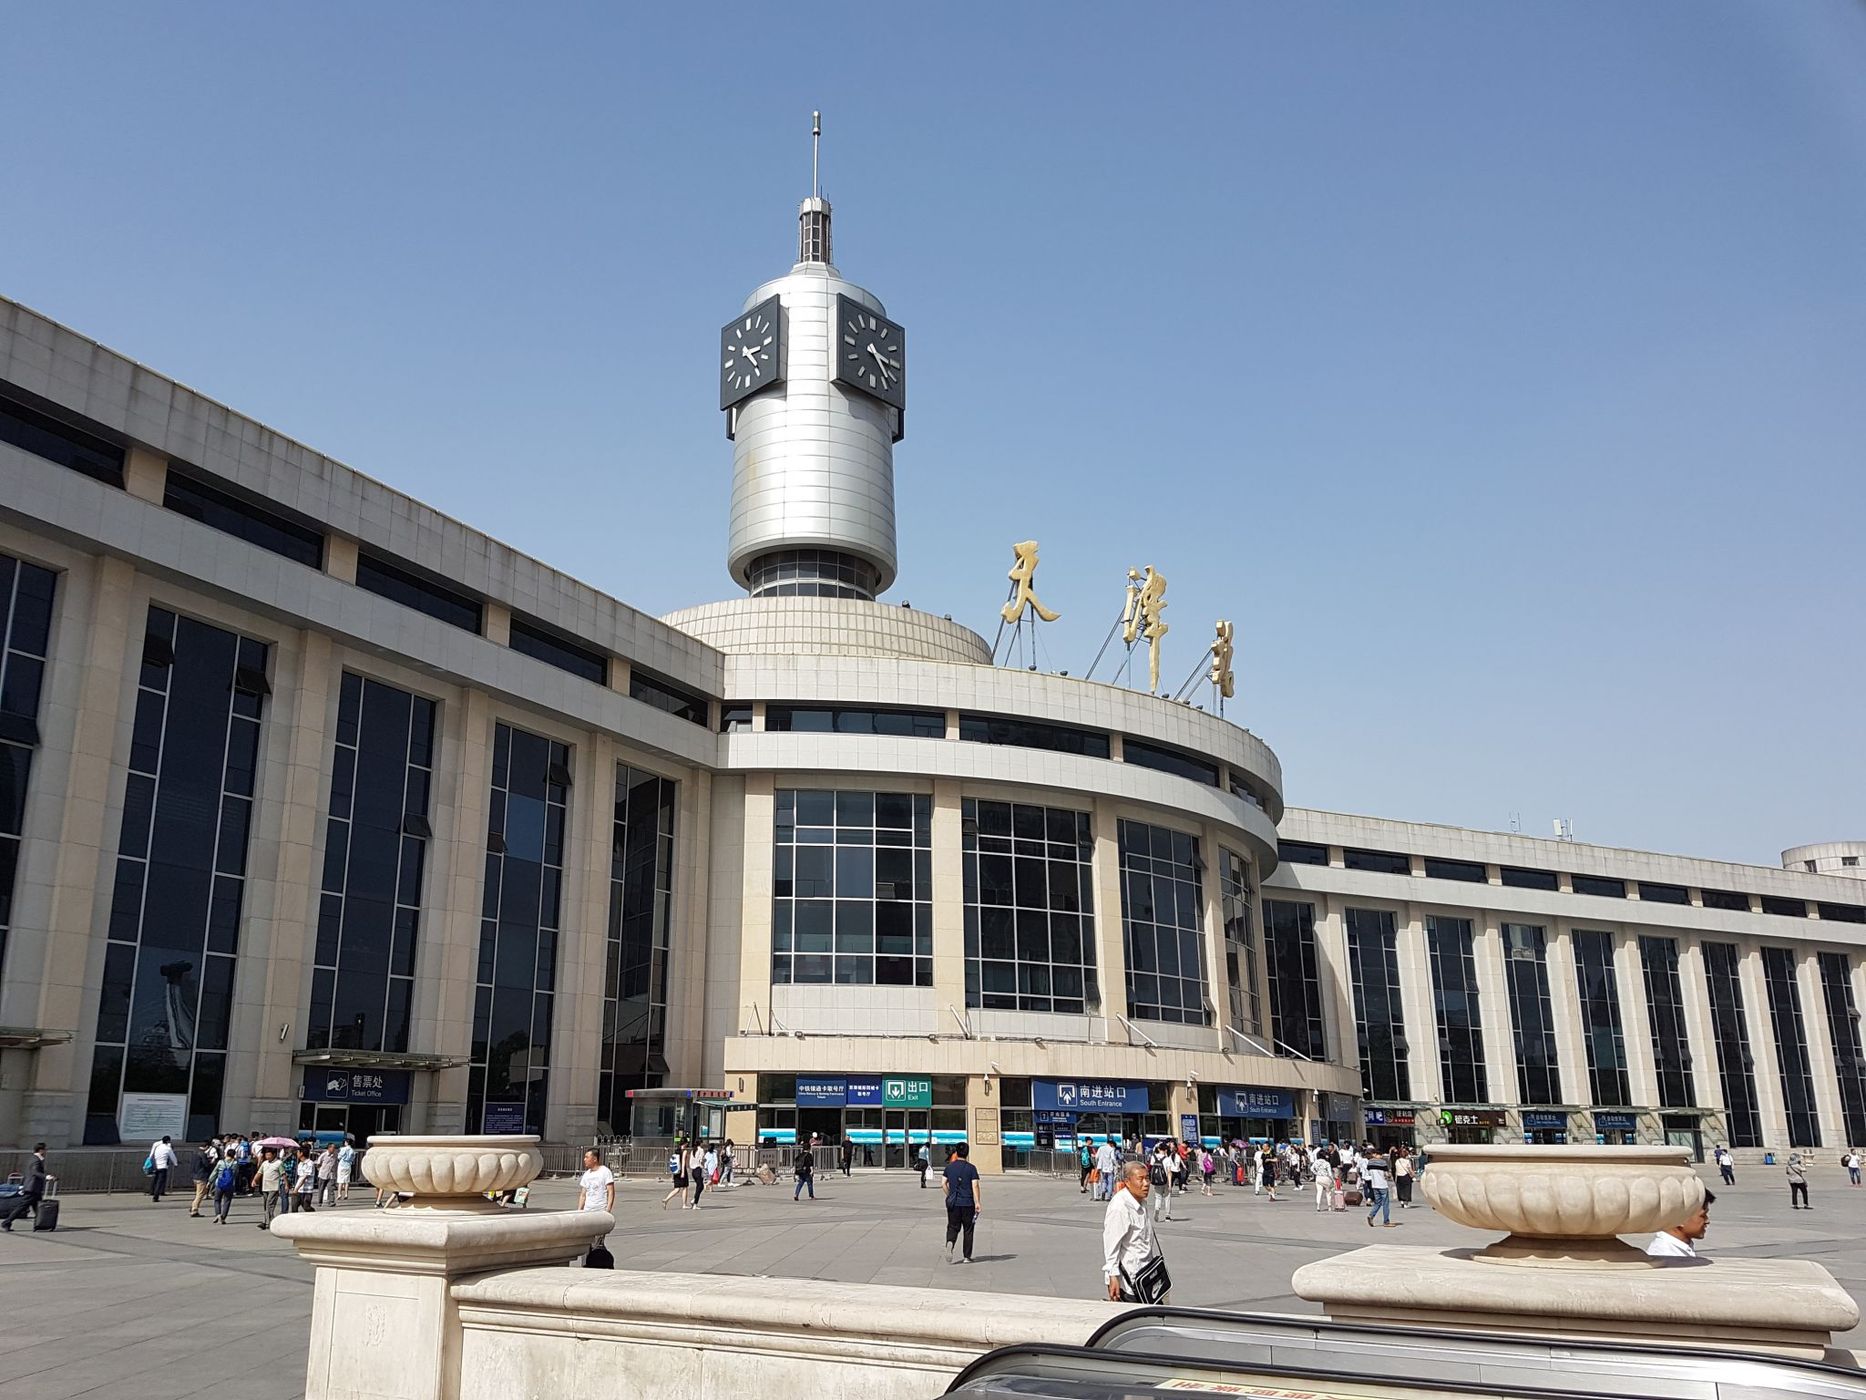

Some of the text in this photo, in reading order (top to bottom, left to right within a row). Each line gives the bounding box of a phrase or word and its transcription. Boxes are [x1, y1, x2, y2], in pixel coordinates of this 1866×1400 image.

[352, 1075, 383, 1089] 售票处
[908, 1081, 929, 1093] 出口
[1079, 1084, 1126, 1099] 南进站口
[1079, 1099, 1123, 1108] South Entrance
[1249, 1093, 1279, 1106] 南进站口
[1454, 1115, 1479, 1125] 德克士
